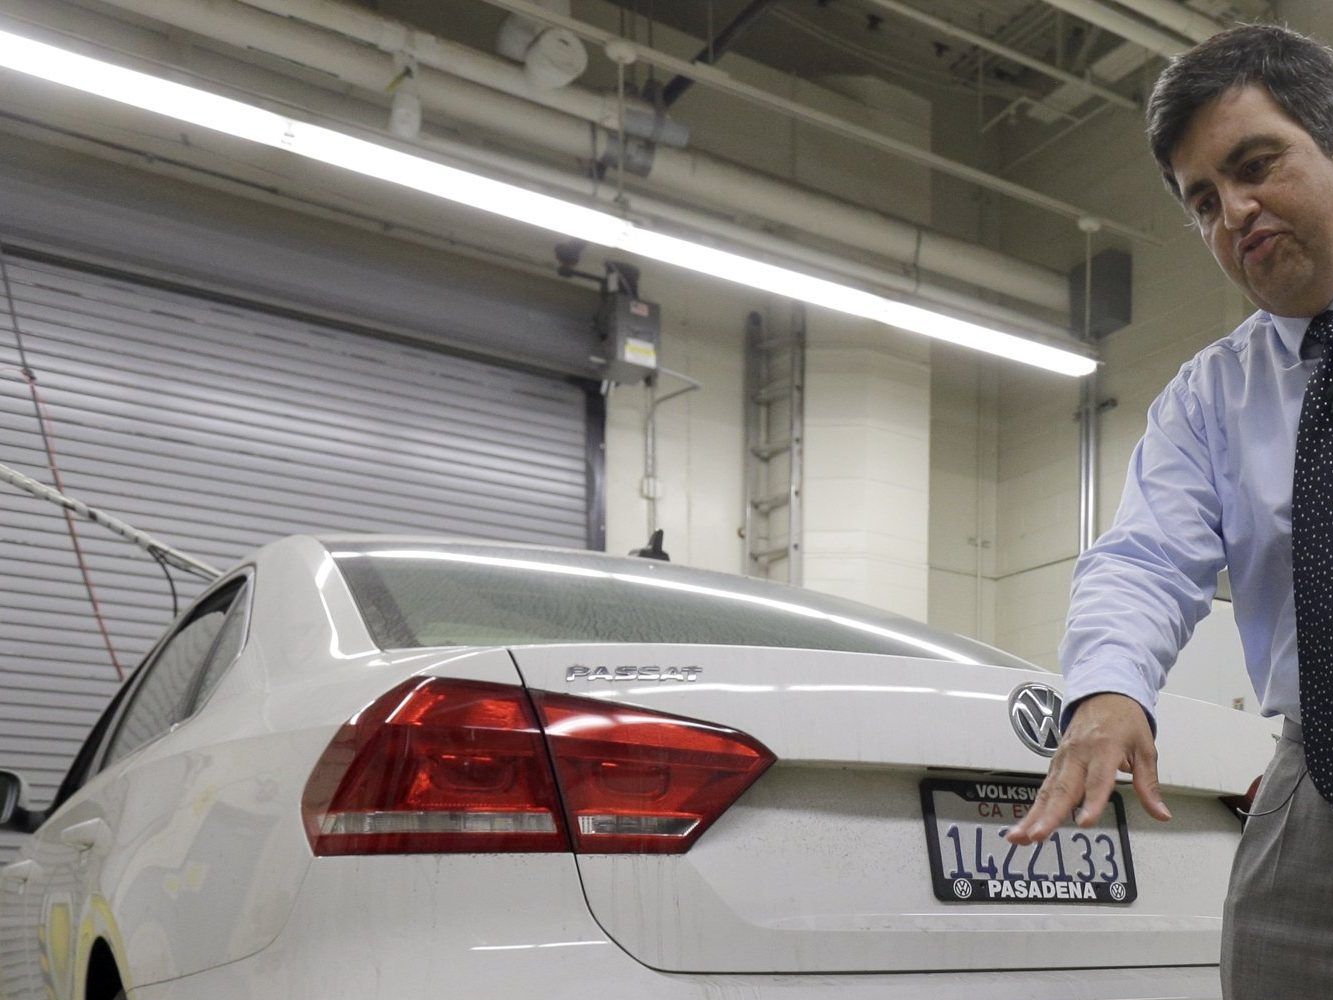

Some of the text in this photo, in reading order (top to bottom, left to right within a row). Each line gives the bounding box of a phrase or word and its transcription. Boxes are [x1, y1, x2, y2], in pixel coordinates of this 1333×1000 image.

[566, 664, 703, 681] PASSAT
[976, 784, 1041, 801] VOLKSW
[978, 803, 1003, 818] CA
[988, 881, 1096, 899] PASADENA
